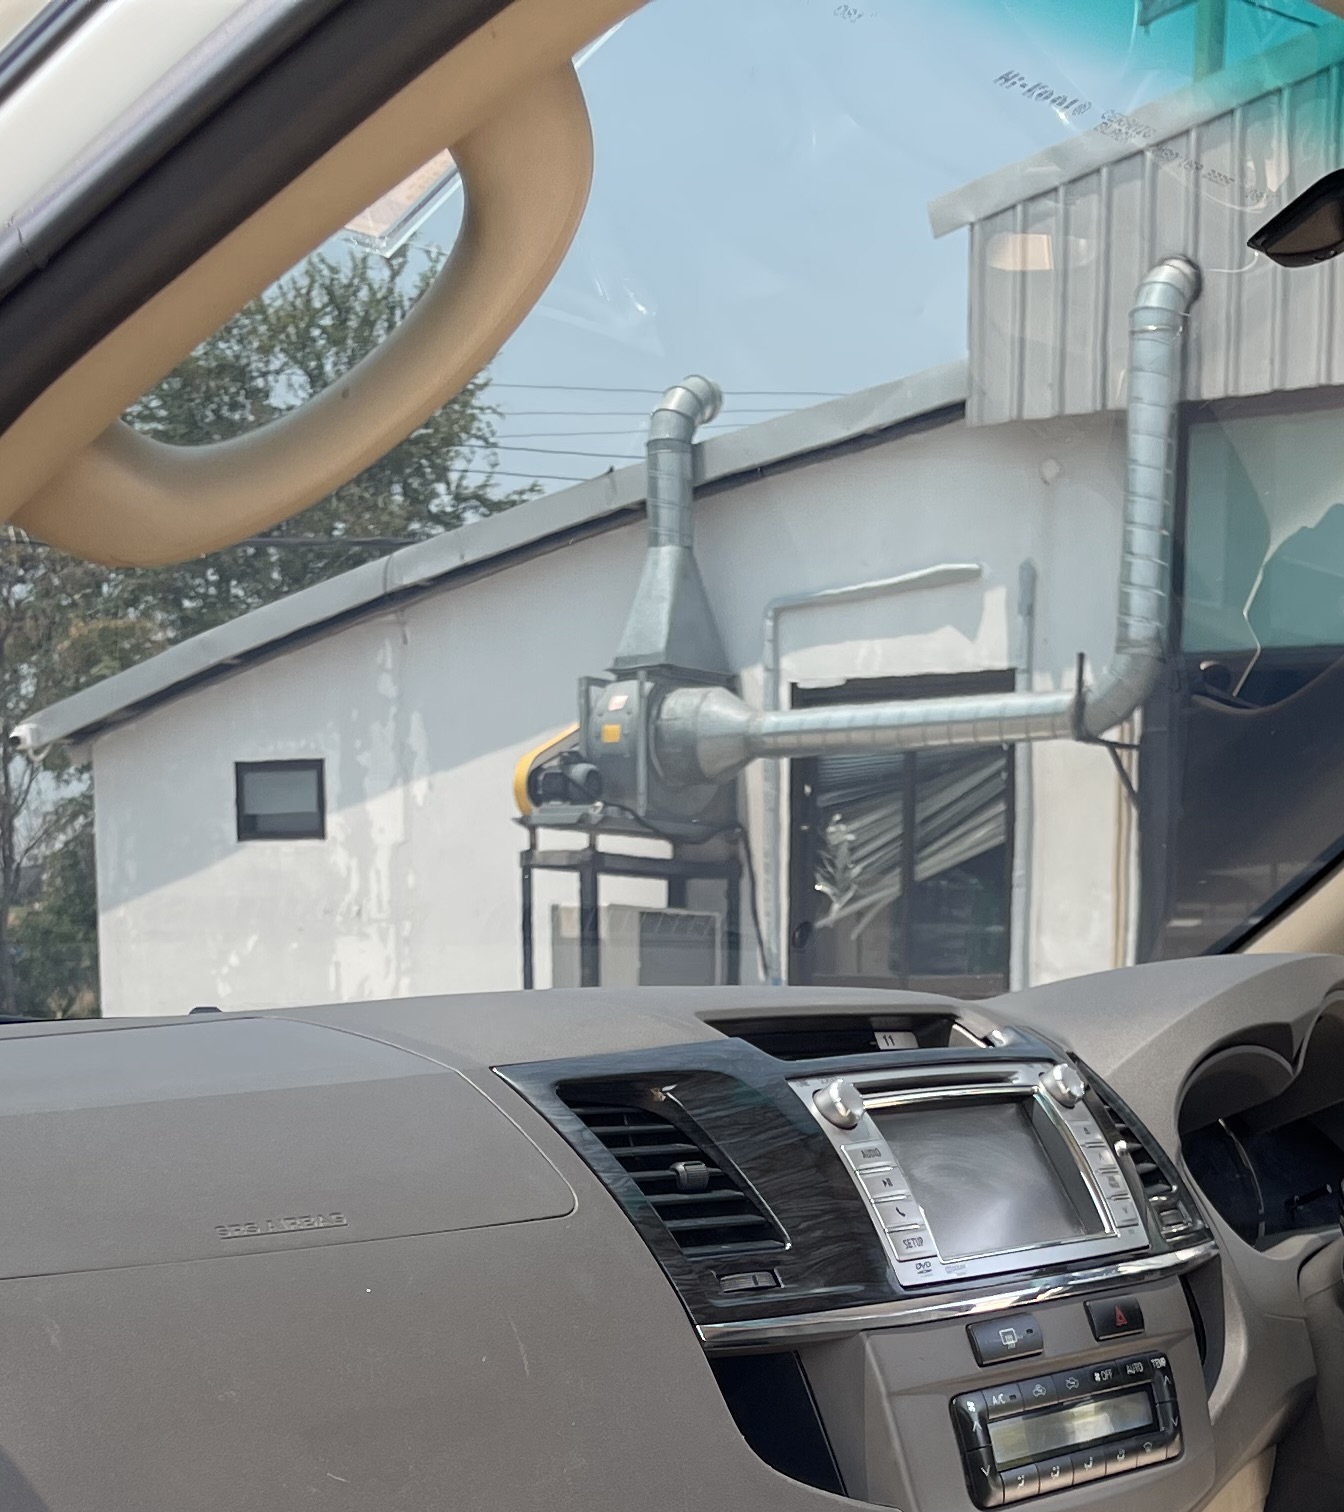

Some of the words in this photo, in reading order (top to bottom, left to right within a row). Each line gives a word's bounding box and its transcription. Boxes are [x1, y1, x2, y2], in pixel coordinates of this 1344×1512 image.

[902, 1236, 924, 1250] SETUP
[1125, 1361, 1144, 1375] AUTO
[1150, 1356, 1167, 1369] TEMP
[1100, 1368, 1113, 1381] OFF
